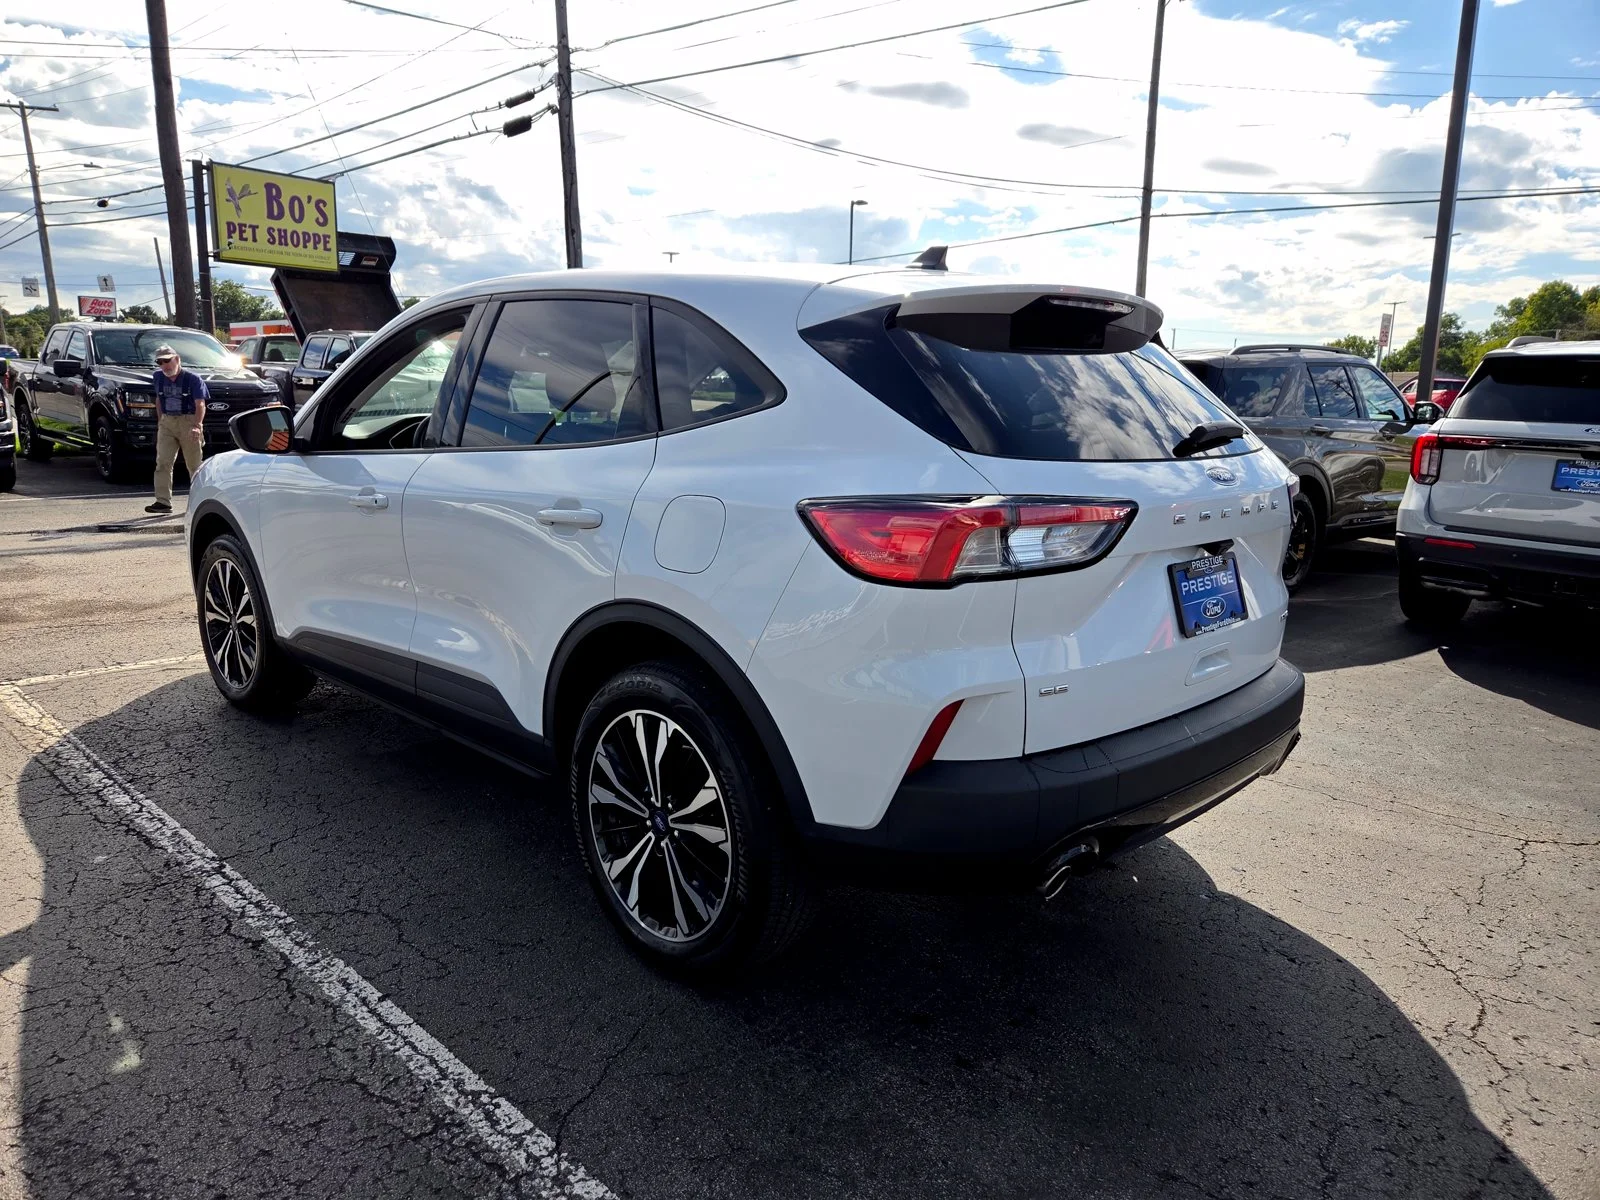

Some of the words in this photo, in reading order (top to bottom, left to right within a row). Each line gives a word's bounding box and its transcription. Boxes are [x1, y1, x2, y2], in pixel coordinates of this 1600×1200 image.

[225, 221, 259, 243] PET
[266, 226, 331, 252] SHOPPE
[90, 298, 113, 308] Auto
[86, 306, 111, 316] Zone
[1173, 500, 1279, 525] ESCAPE
[1191, 555, 1223, 569] PRESTIGE
[1181, 571, 1234, 595] PRESTIGE
[1206, 599, 1222, 616] Ford
[1039, 684, 1069, 697] SE
